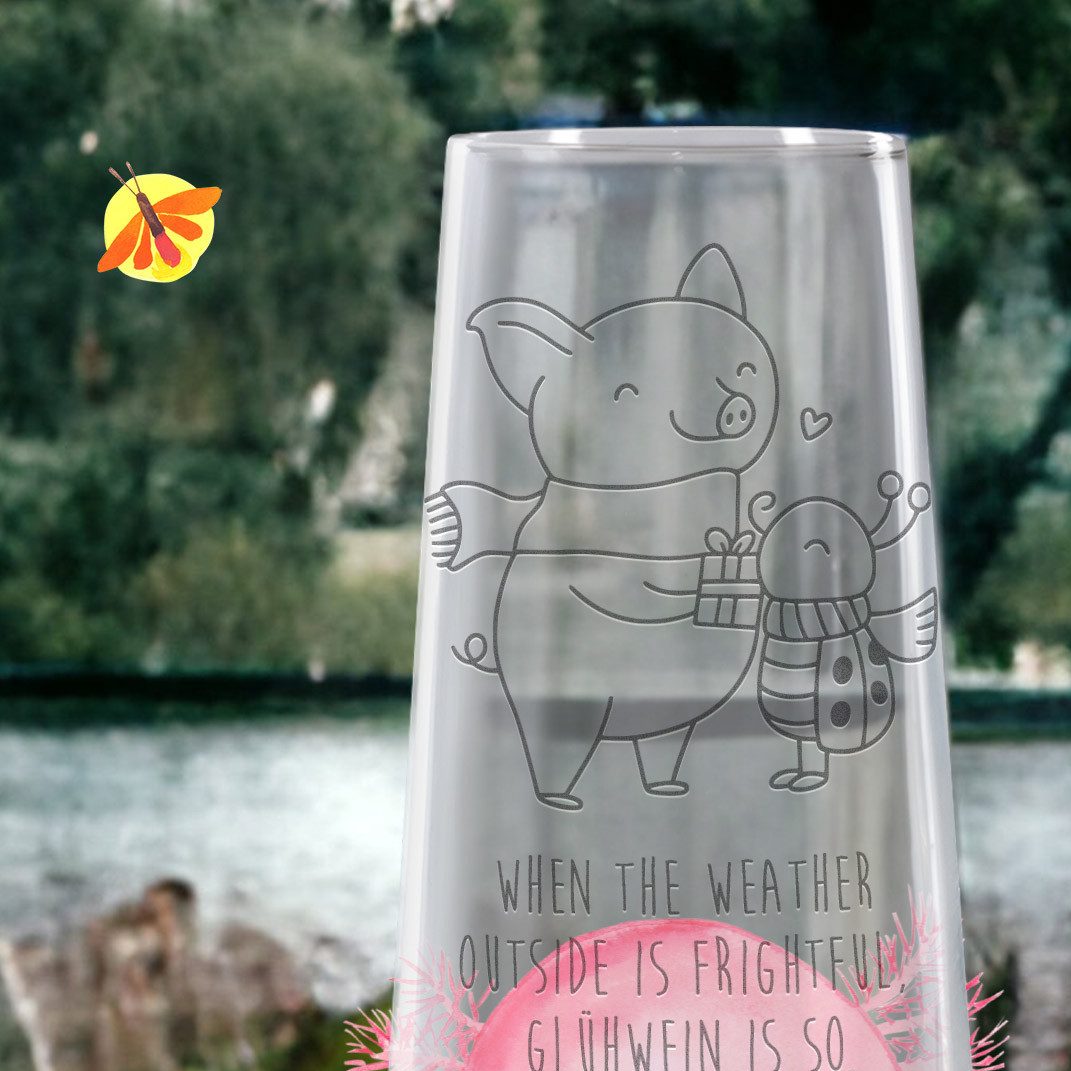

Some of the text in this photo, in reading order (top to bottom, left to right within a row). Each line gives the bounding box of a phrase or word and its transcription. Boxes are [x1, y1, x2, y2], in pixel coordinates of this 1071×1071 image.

[497, 851, 873, 917] WHEN THE WEATHER
[459, 930, 905, 997] OUTSIDE IS FRIGHTFUL,
